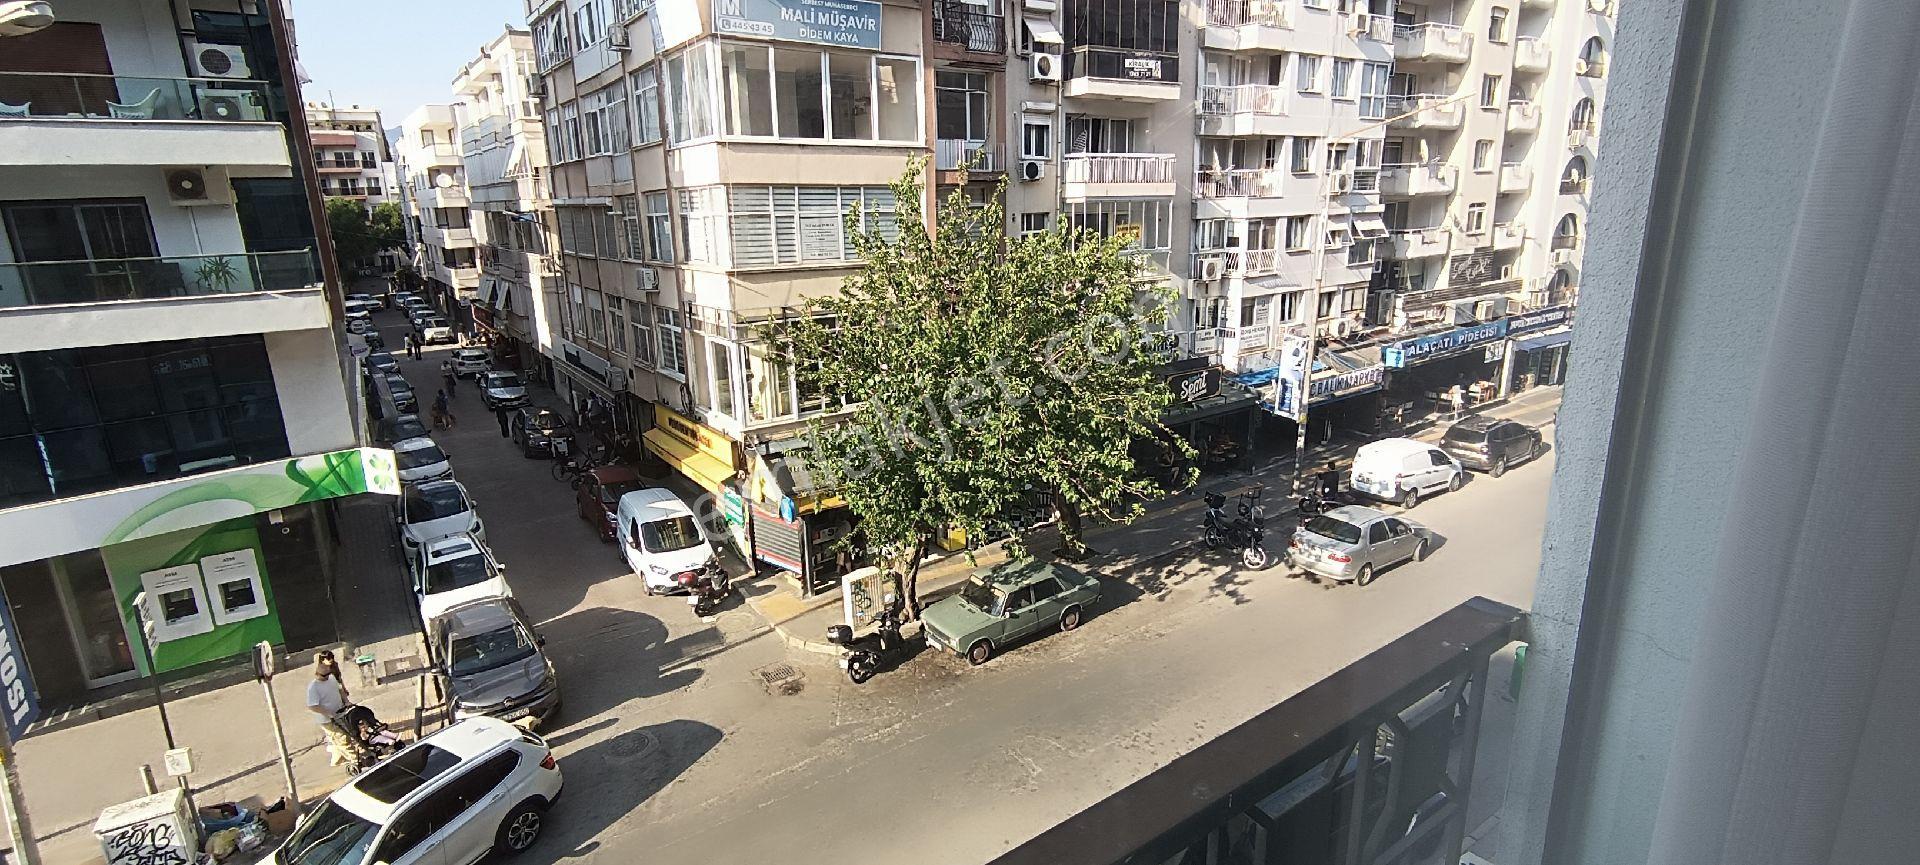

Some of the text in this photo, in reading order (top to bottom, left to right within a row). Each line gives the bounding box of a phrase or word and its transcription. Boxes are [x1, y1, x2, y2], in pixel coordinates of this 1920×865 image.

[781, 7, 876, 32] MALİ MÜŞAVİR
[800, 26, 859, 44] DİDEM KAYA
[1408, 338, 1453, 357] ALAÇATI
